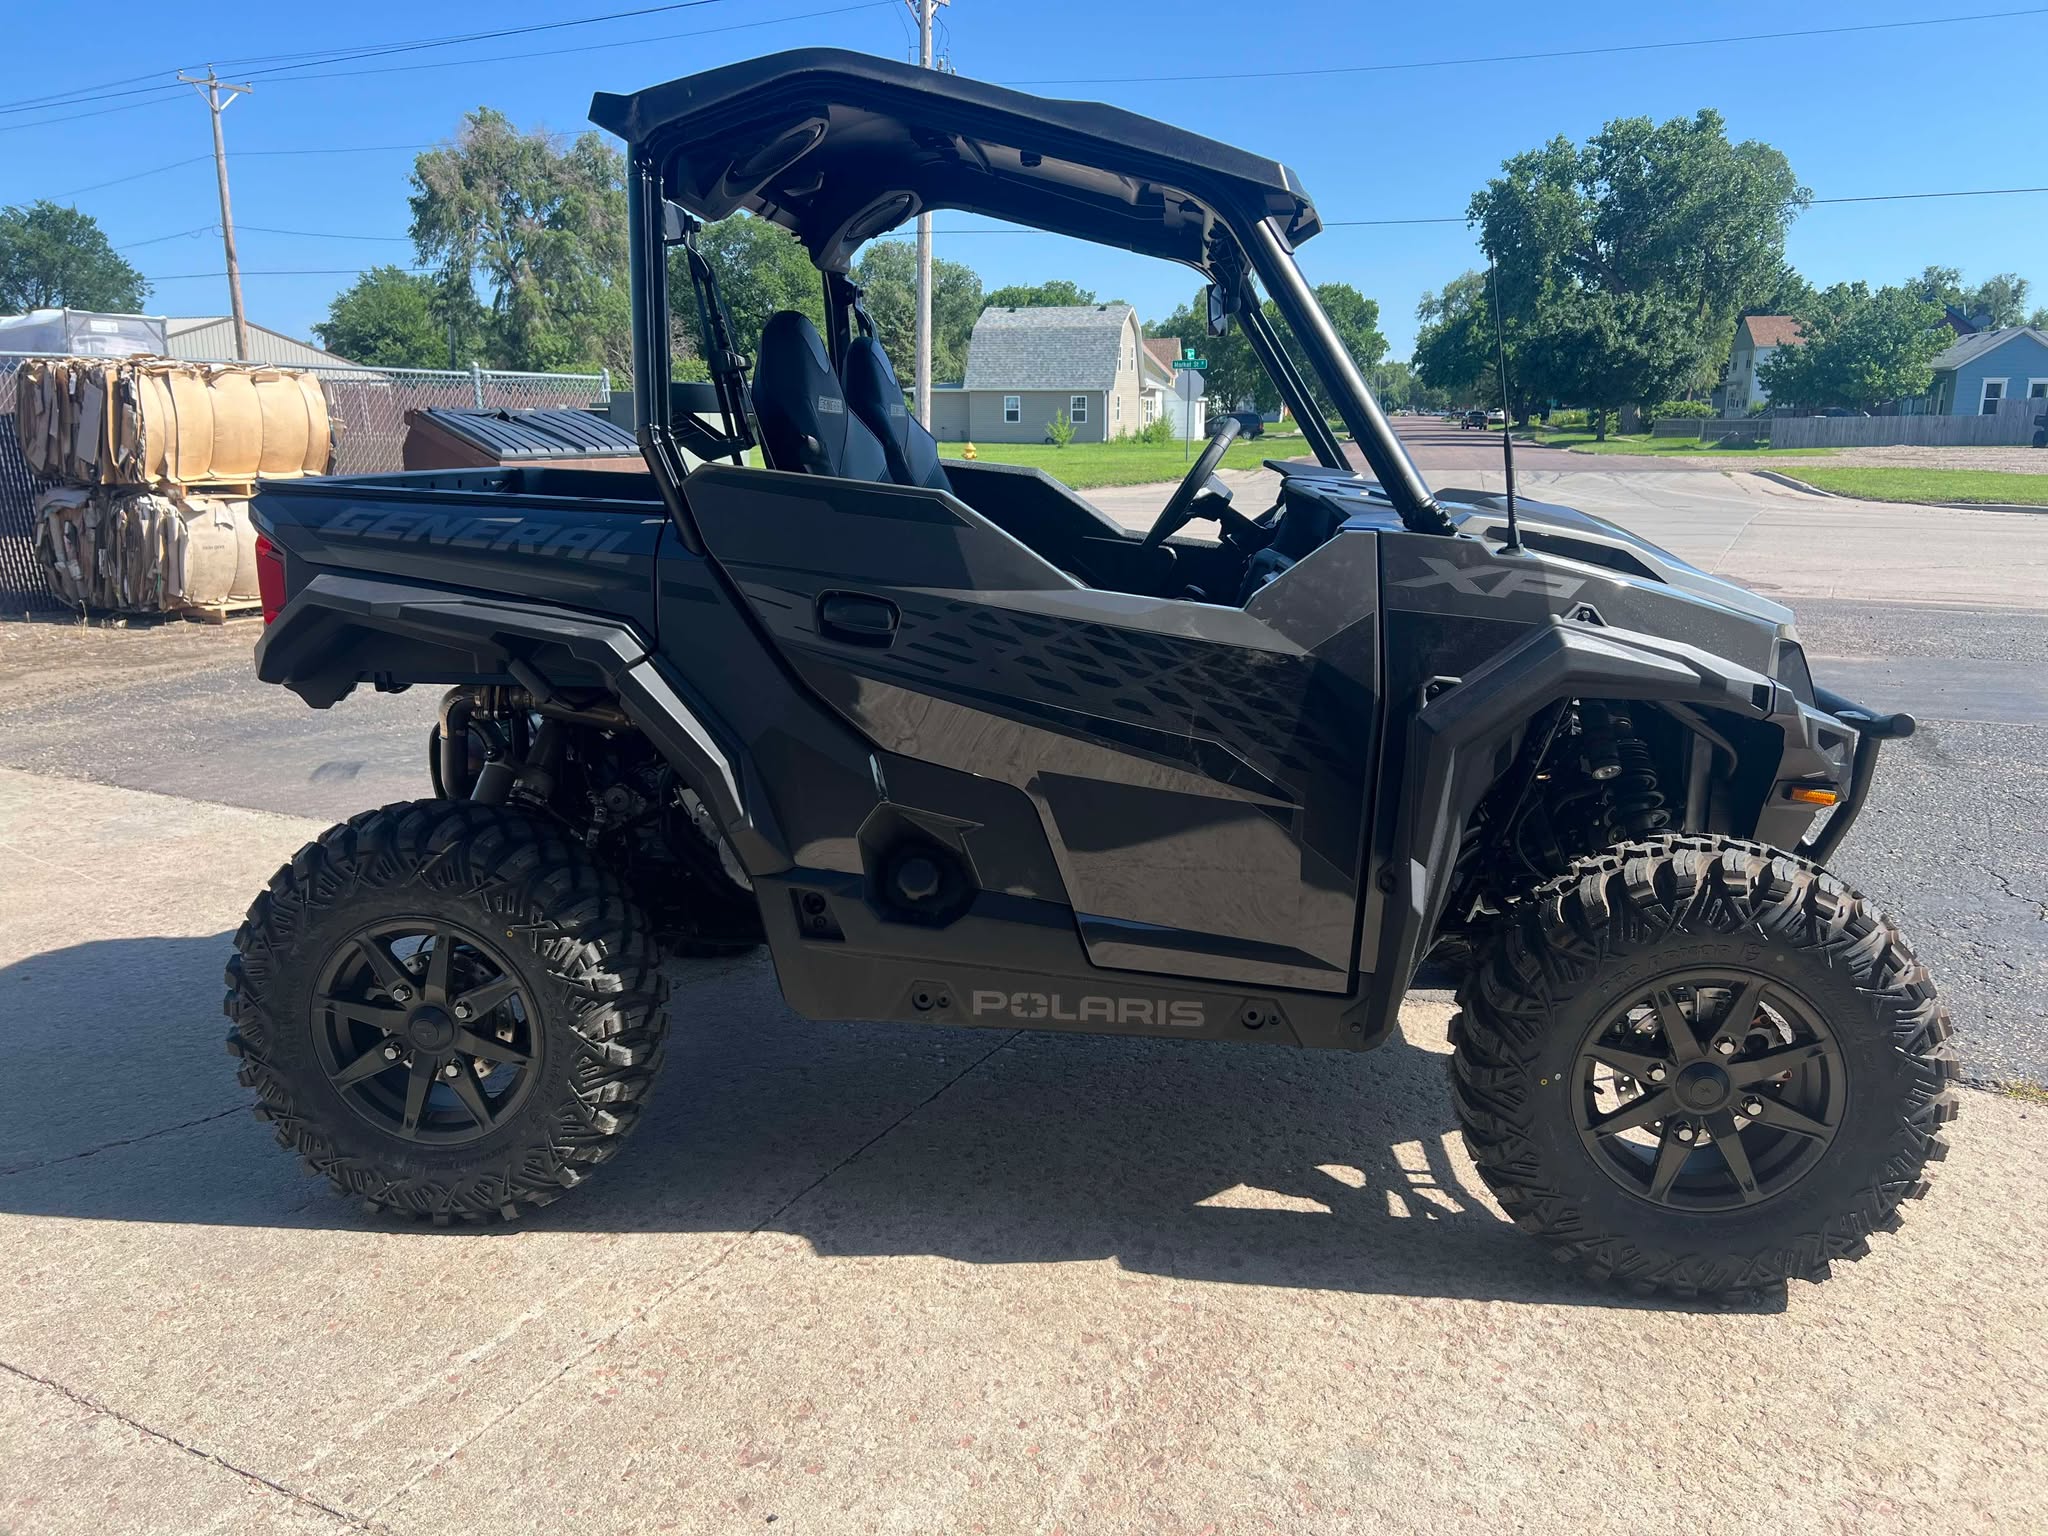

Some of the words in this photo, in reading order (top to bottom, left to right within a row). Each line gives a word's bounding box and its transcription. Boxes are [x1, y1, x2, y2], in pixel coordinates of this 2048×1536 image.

[317, 506, 633, 565] GENERAL
[1387, 556, 1588, 600] XP
[972, 990, 1206, 1028] POLARIS
